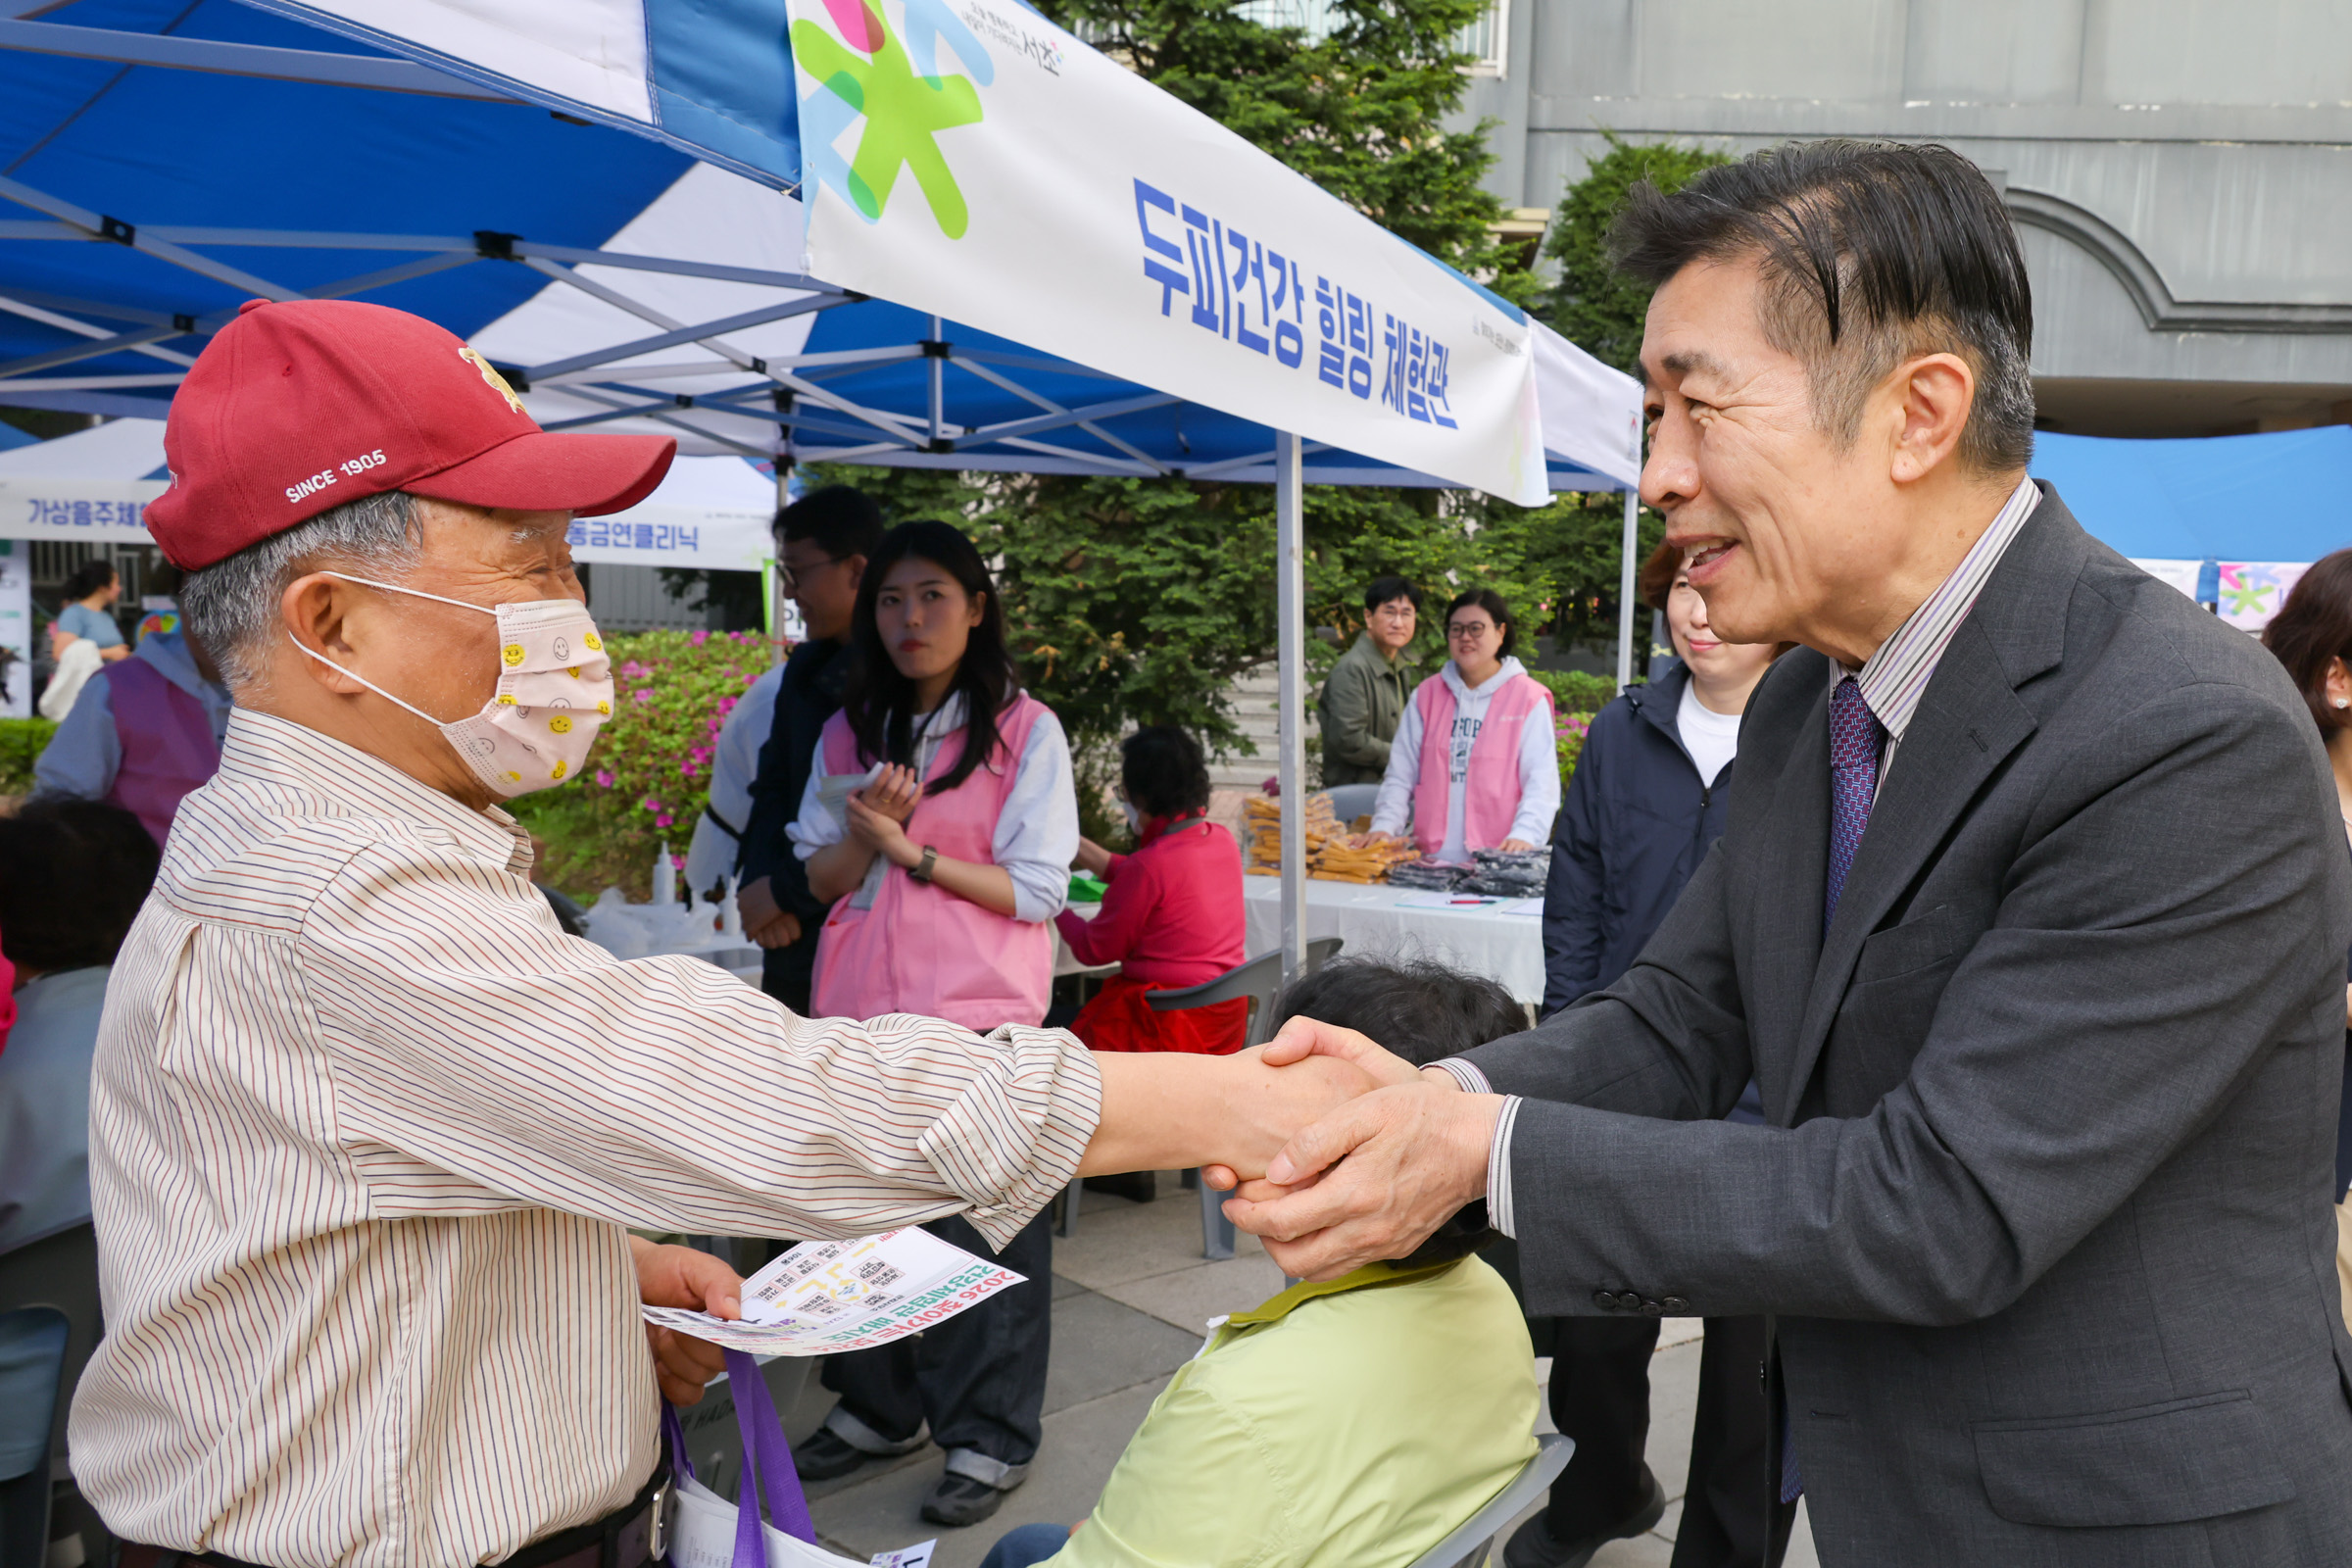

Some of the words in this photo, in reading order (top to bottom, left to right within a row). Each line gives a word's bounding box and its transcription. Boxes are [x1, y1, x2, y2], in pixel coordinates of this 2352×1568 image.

[1022, 30, 1059, 77] 서초
[1133, 176, 1304, 369] 두피건강
[1315, 274, 1373, 400] 힐링
[1382, 313, 1458, 429] 체험관
[285, 469, 337, 503] SINCE
[340, 449, 386, 475] 1905
[28, 500, 147, 527] 가상음주체
[890, 1264, 996, 1317] 건강체험관
[959, 1271, 1015, 1300] 2026
[821, 1316, 896, 1343] 배치도
[872, 1299, 963, 1339] 찾아가는
